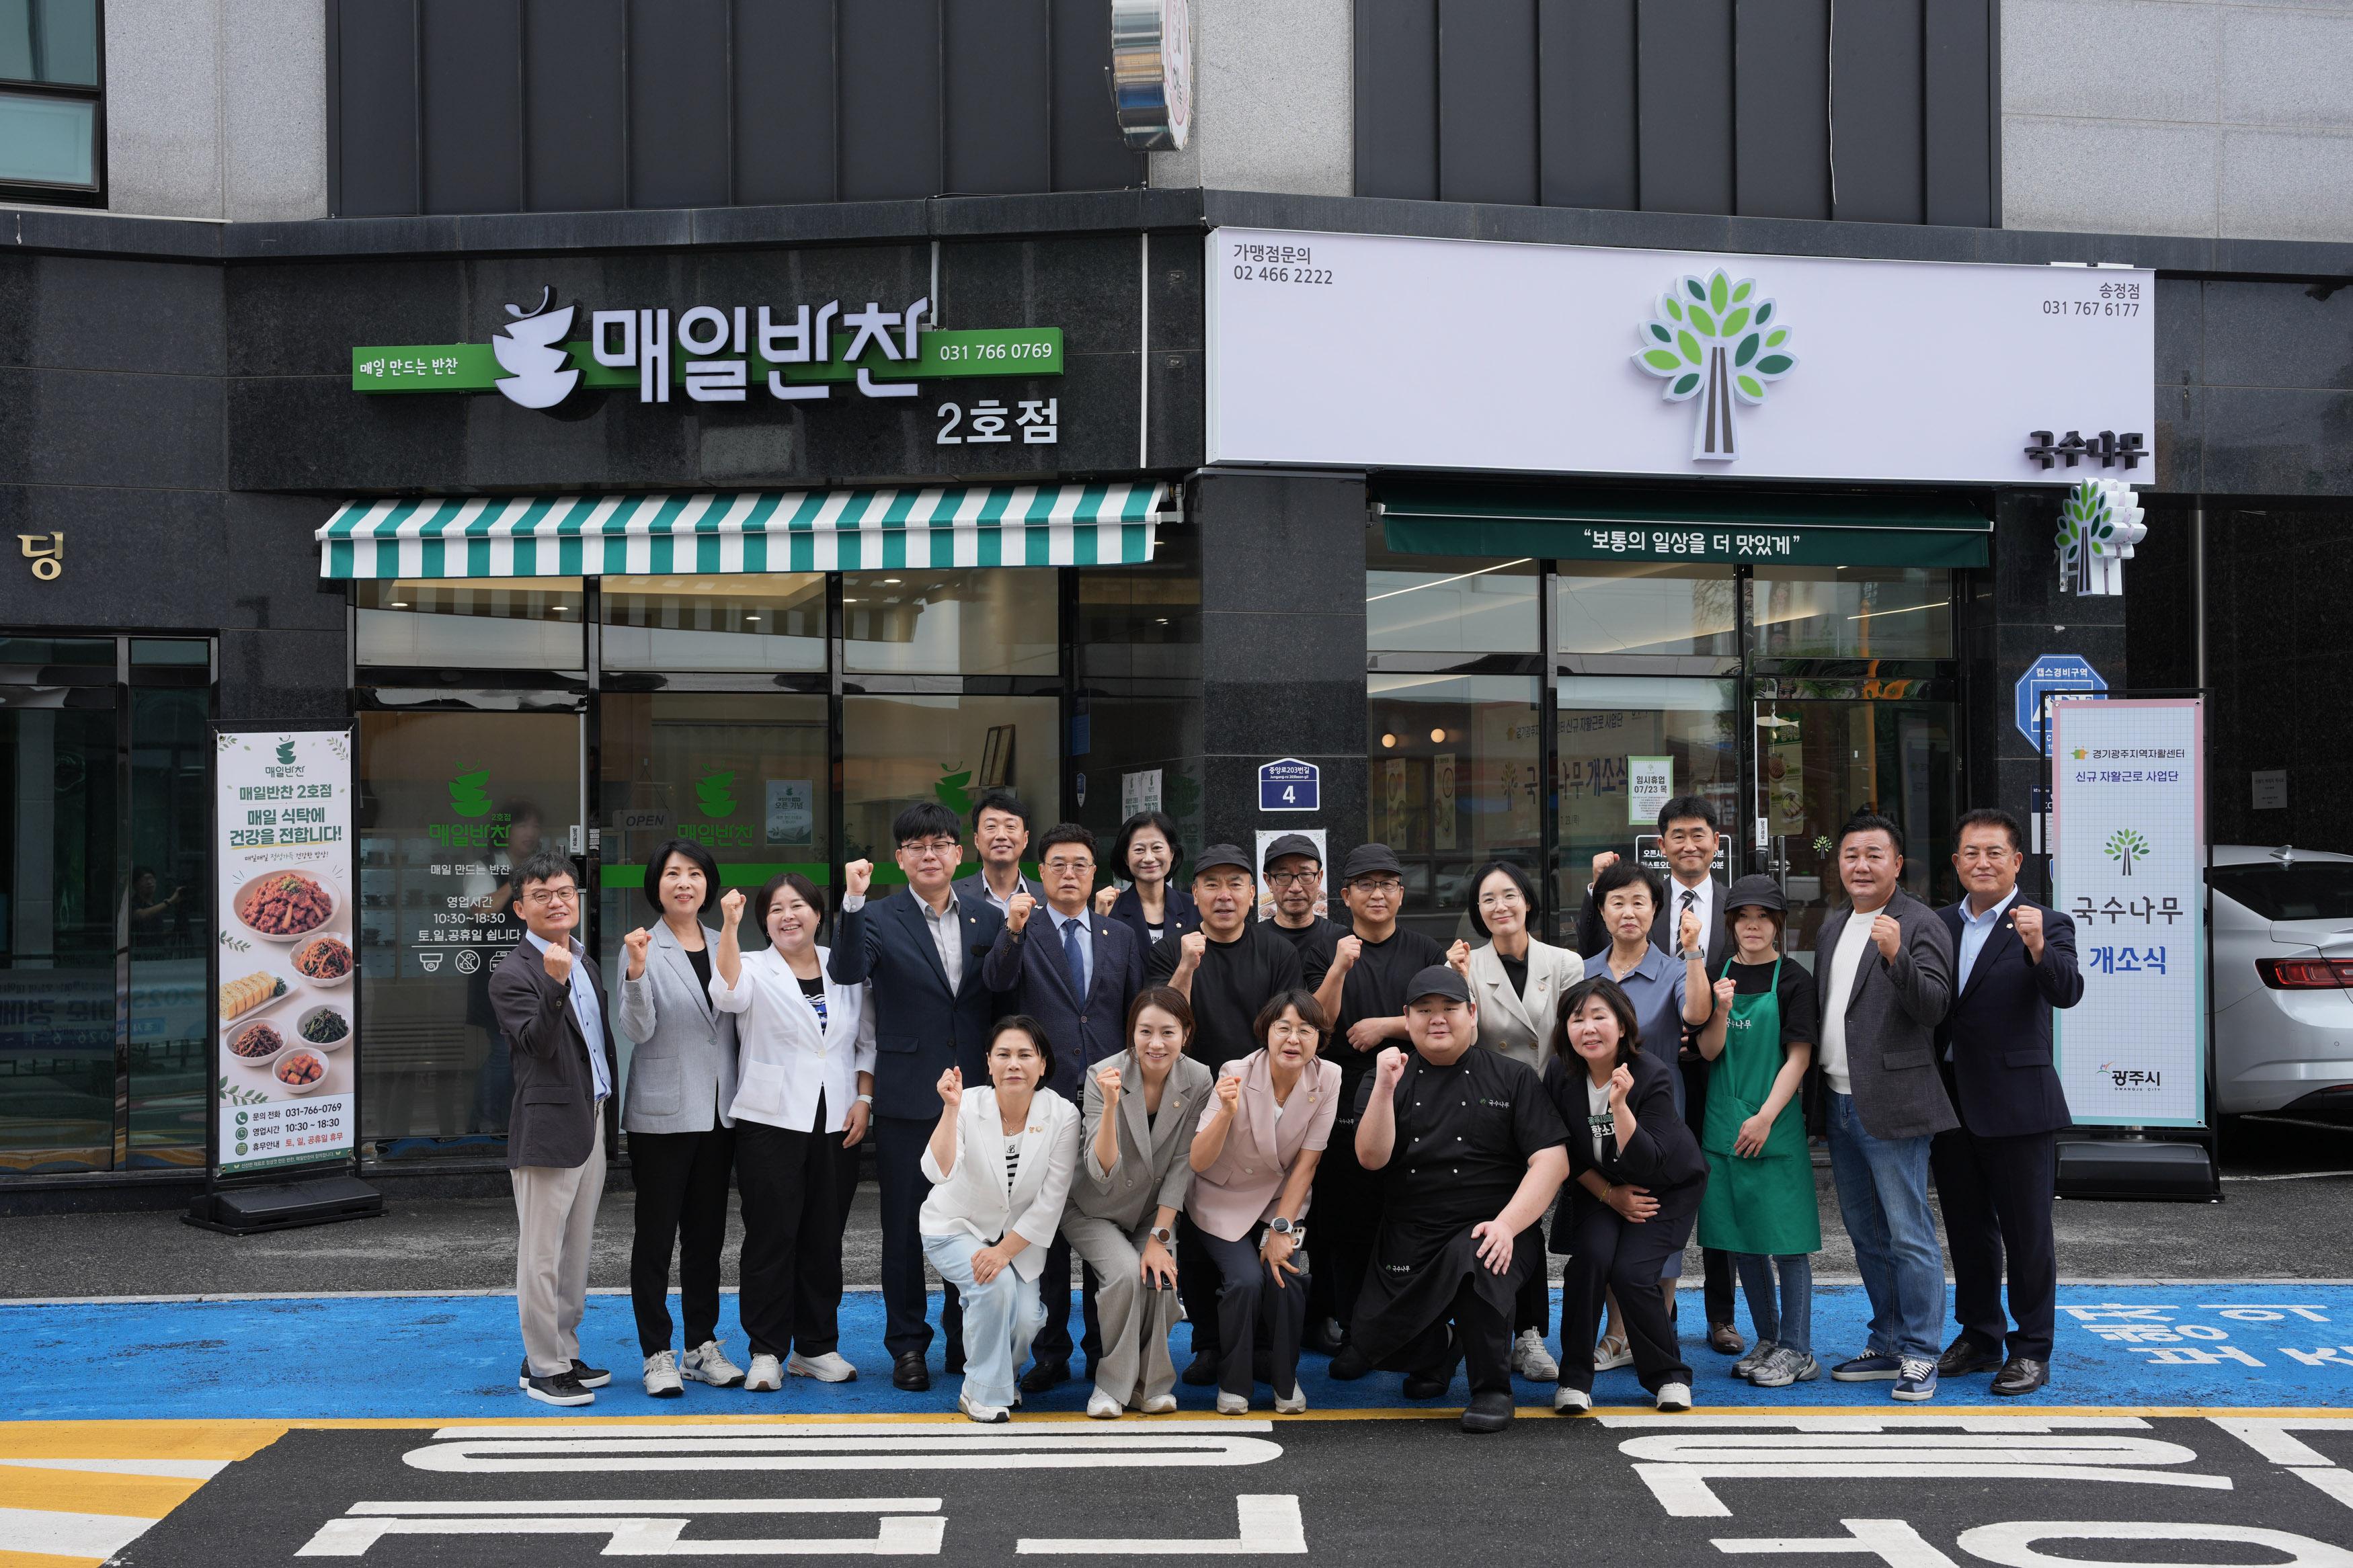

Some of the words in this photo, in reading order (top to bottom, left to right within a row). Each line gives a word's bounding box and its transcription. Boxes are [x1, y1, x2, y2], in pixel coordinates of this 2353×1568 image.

[1234, 244, 1310, 264] 가맹점문의
[1234, 265, 1252, 280] 02
[1259, 267, 1288, 282] 466
[1294, 269, 1332, 284] 2222
[2099, 282, 2141, 300] 송정점
[2042, 300, 2067, 314] 031
[2074, 302, 2100, 315] 767
[2104, 302, 2139, 317] 6177
[592, 296, 932, 403] 매일반찬
[940, 345, 969, 361] 031
[975, 344, 1006, 360] 766
[1011, 342, 1052, 358] 0769
[360, 358, 385, 377] 매일
[389, 358, 428, 376] 만드는
[432, 357, 458, 375] 반찬
[936, 398, 1058, 444] 2호점
[2024, 430, 2149, 470] 국수나무
[1584, 529, 1645, 552] “보통의
[1652, 532, 1706, 554] 일상을
[1714, 534, 1729, 553] 더
[1737, 535, 1800, 555] 맛있게”
[17, 531, 63, 580] 딩
[2036, 667, 2087, 677] 캡스경비구역
[1566, 718, 1579, 733] 신규
[1605, 712, 1623, 729] 사업단
[2092, 749, 2184, 759] 경기광주지역자활센터
[265, 766, 305, 778] 매일반찬
[1269, 766, 1310, 774] 중앙로203번길
[2075, 771, 2097, 782] 신규
[2100, 771, 2143, 782] 자활근로
[2146, 771, 2179, 782] 사업단
[1525, 761, 1583, 804] 국나무
[1586, 757, 1628, 796] 개소식
[1636, 776, 1665, 784] 임시휴업
[239, 784, 294, 800] 매일반찬
[296, 784, 332, 798] 2호점
[1282, 785, 1295, 803] 4
[1634, 785, 1658, 794] 07/23
[1661, 785, 1667, 794] 목
[790, 802, 803, 810] 기념
[247, 809, 276, 825] 매일
[281, 807, 325, 825] 식탁에
[491, 813, 511, 821] 2호점
[626, 815, 666, 827] OPEN
[230, 828, 275, 846] 건강을
[280, 825, 342, 844] 전합니다!
[429, 823, 511, 848] 매일반찬
[677, 823, 754, 846] 매일반찬
[245, 853, 268, 862] 매일매일
[270, 852, 294, 861] 정성가득
[295, 851, 313, 860] 건강한
[315, 850, 329, 859] 밥상!
[430, 864, 451, 875] 매일
[455, 864, 486, 875] 만드는
[489, 864, 511, 875] 반찬
[447, 896, 493, 908] 영업시간
[2071, 896, 2183, 925] 국수나무
[434, 913, 505, 923] 10:30~18:30
[418, 930, 482, 942] 토.일.공휴일
[486, 929, 520, 941] 쉽니다
[2089, 946, 2165, 975] 개소식
[2111, 1070, 2160, 1086] 광주시
[253, 1112, 266, 1121] 문의
[268, 1110, 280, 1120] 전화
[285, 1103, 342, 1117] 031-766-0769
[1488, 1099, 1510, 1108] 국수나무
[253, 1126, 280, 1137] 영업시간
[285, 1122, 308, 1132] 10:30
[317, 1118, 340, 1128] 18:30
[253, 1141, 280, 1151] 휴무안내
[285, 1138, 294, 1147] 토,
[297, 1137, 306, 1146] 일,
[308, 1134, 327, 1145] 공휴일
[329, 1132, 344, 1142] 휴무
[1392, 1265, 1410, 1273] 국수나무
